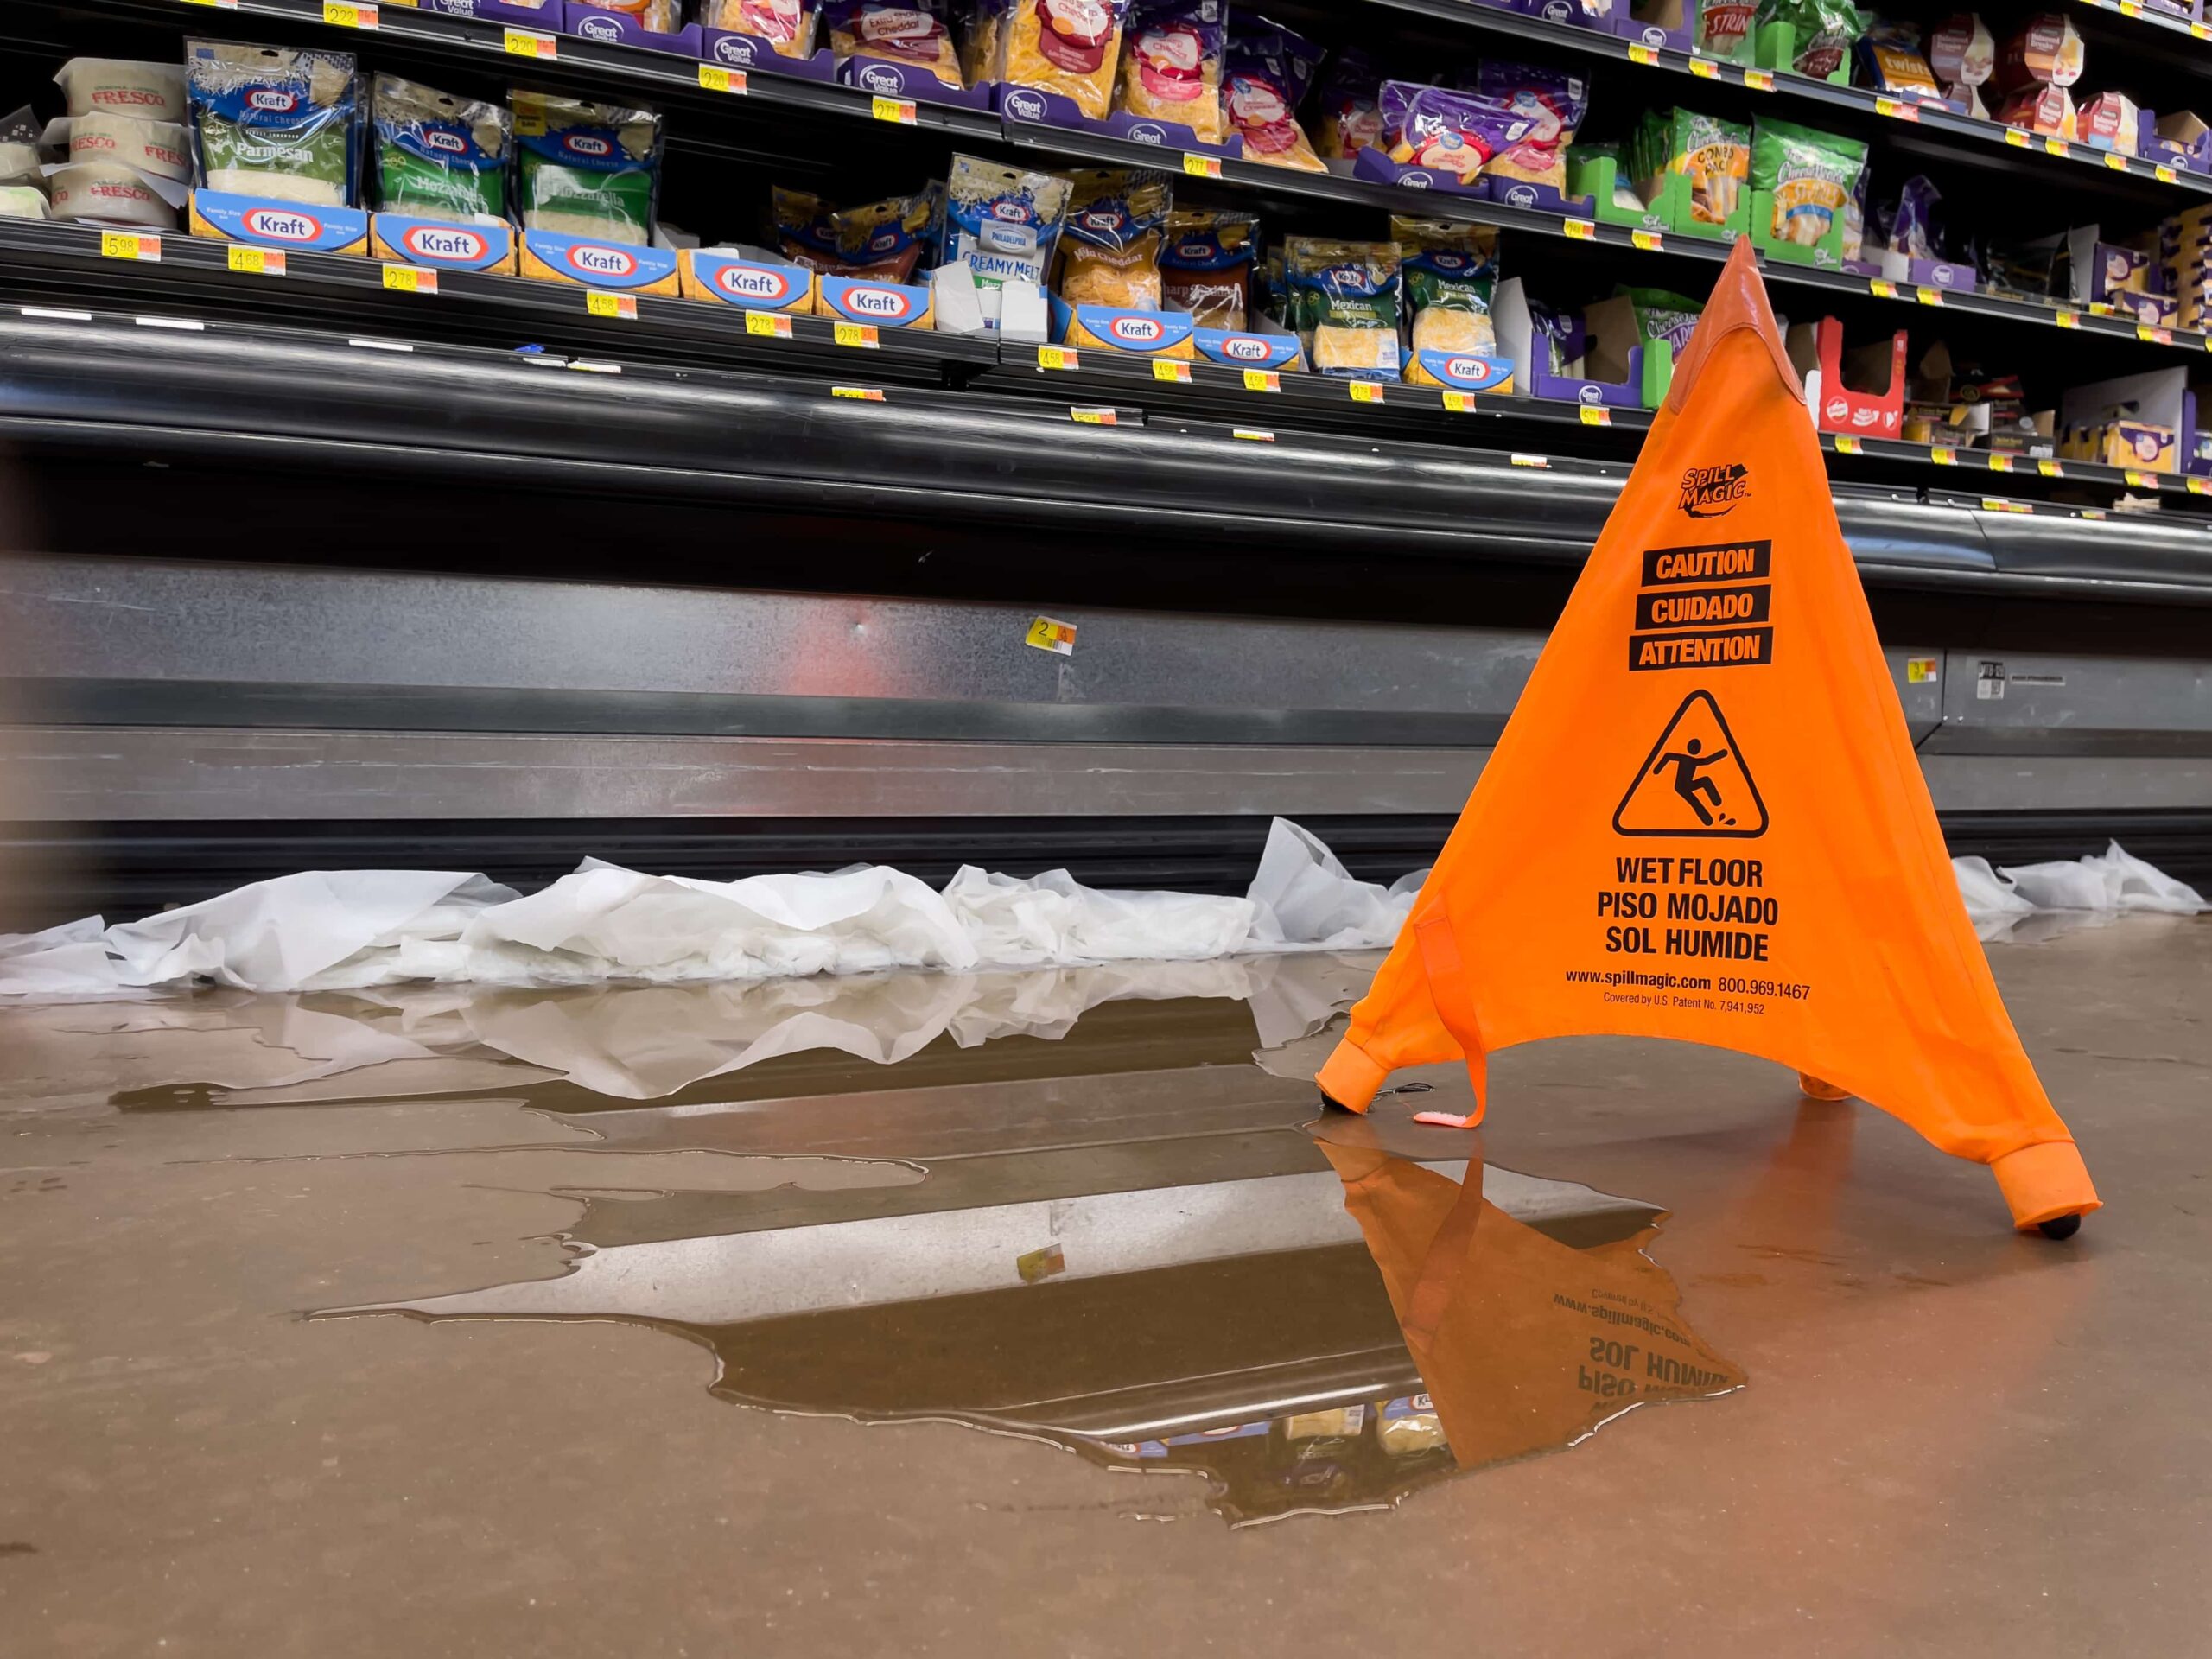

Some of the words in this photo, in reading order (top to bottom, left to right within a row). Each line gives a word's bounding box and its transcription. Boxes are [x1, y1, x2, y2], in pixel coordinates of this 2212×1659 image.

[448, 5, 473, 16] Value
[1547, 5, 1568, 17] Great
[585, 22, 618, 36] Great
[877, 21, 919, 35] Cheddar
[1709, 11, 1747, 34] STRIN
[720, 42, 752, 57] Great
[728, 53, 753, 65] Value
[866, 71, 898, 87] Great
[92, 91, 166, 106] FRESCO
[256, 93, 287, 107] Kraft
[1011, 95, 1042, 112] Great
[1017, 107, 1041, 119] Value
[71, 137, 116, 152] RESCO
[433, 134, 461, 149] Kraft
[573, 138, 602, 152] Kraft
[1133, 130, 1161, 144] Great
[144, 145, 186, 167] FRES
[236, 142, 314, 162] Parmesan
[1403, 177, 1427, 189] Great
[556, 183, 626, 207] ozzarella
[1510, 190, 1534, 205] Great
[999, 206, 1021, 218] Kraft
[259, 214, 306, 237] Kraft
[108, 237, 134, 256] 598
[423, 234, 470, 254] Kraft
[1184, 247, 1207, 256] Kraft
[234, 252, 259, 270] 468
[582, 251, 622, 271] Kraft
[389, 270, 412, 289] 278
[731, 272, 772, 293] Kraft
[1437, 279, 1476, 294] Mexican
[1163, 284, 1189, 297] harp
[856, 293, 896, 312] Kraft
[1330, 299, 1373, 311] Mexican
[1122, 322, 1153, 337] Kraft
[1232, 343, 1261, 357] Kraft
[1454, 363, 1480, 377] Kraft
[1681, 464, 1736, 490] SPILL
[1678, 480, 1747, 510] MAGIC
[1656, 548, 1755, 580] CAUTION
[1651, 593, 1754, 624] CUIDADO
[1638, 635, 1761, 665] ATTENTION
[1616, 857, 1675, 884] WET
[1678, 858, 1763, 888] FLOOR
[1597, 891, 1658, 919] PISO
[1666, 893, 1779, 926] MOJADO
[1605, 925, 1657, 954] SOL
[1664, 928, 1769, 963] HUMIDE
[1566, 970, 1712, 991] www.spillmagic.com
[1718, 977, 1811, 1001] 800.969.1467
[1604, 992, 1640, 1005] Covered
[1641, 994, 1652, 1007] by
[1654, 995, 1669, 1007] U.S.
[1673, 996, 1702, 1009] Patent
[1703, 1000, 1717, 1011] No.
[1719, 1001, 1765, 1015] 7,941,952
